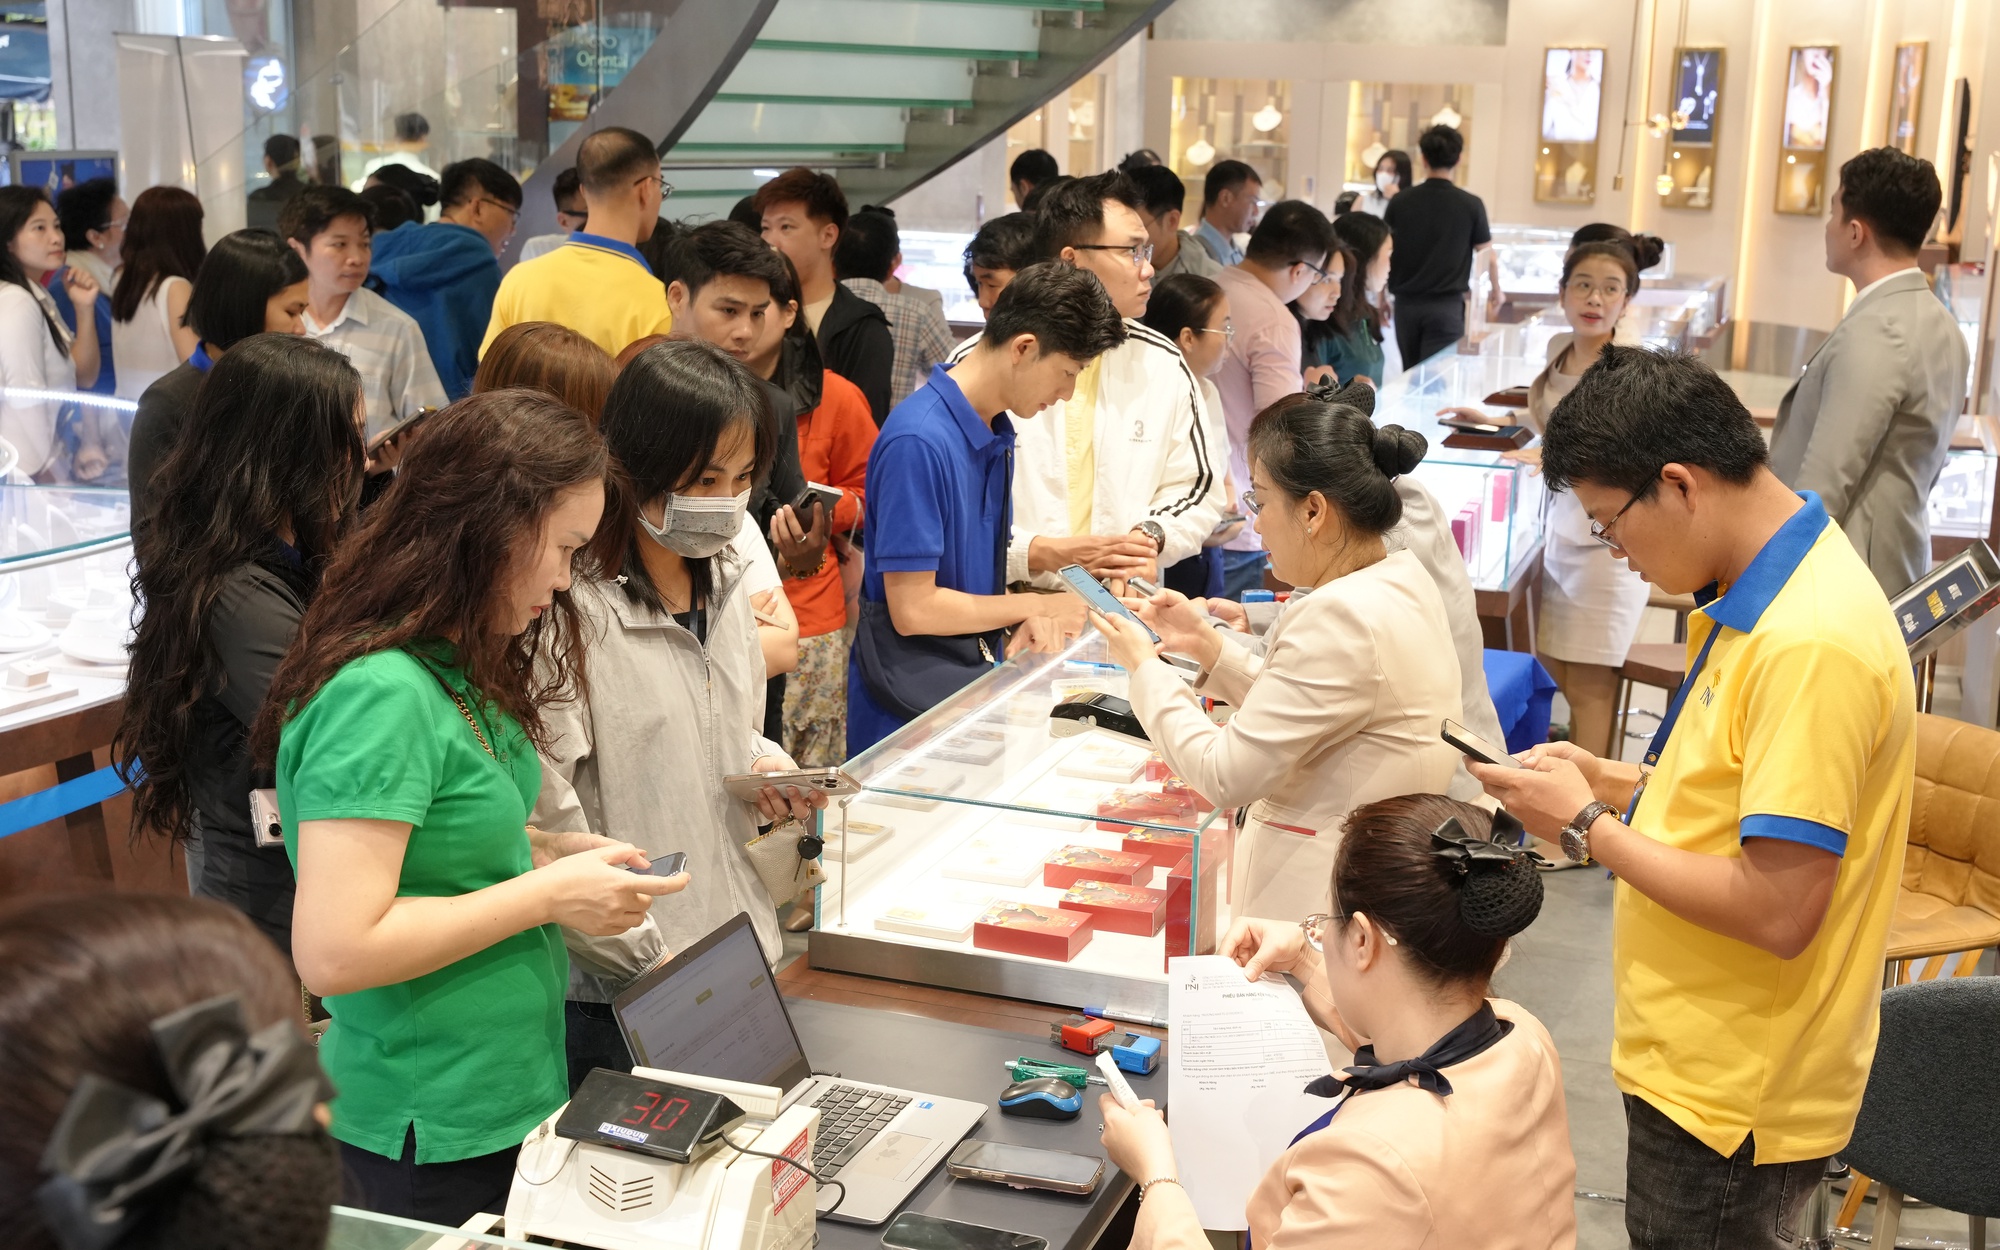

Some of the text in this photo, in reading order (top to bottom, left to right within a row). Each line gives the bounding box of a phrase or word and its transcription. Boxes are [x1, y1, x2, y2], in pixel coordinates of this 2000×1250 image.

[576, 50, 628, 68] Orental
[1134, 419, 1144, 438] 3
[1185, 983, 1199, 991] PNJ
[621, 1091, 691, 1131] 30
